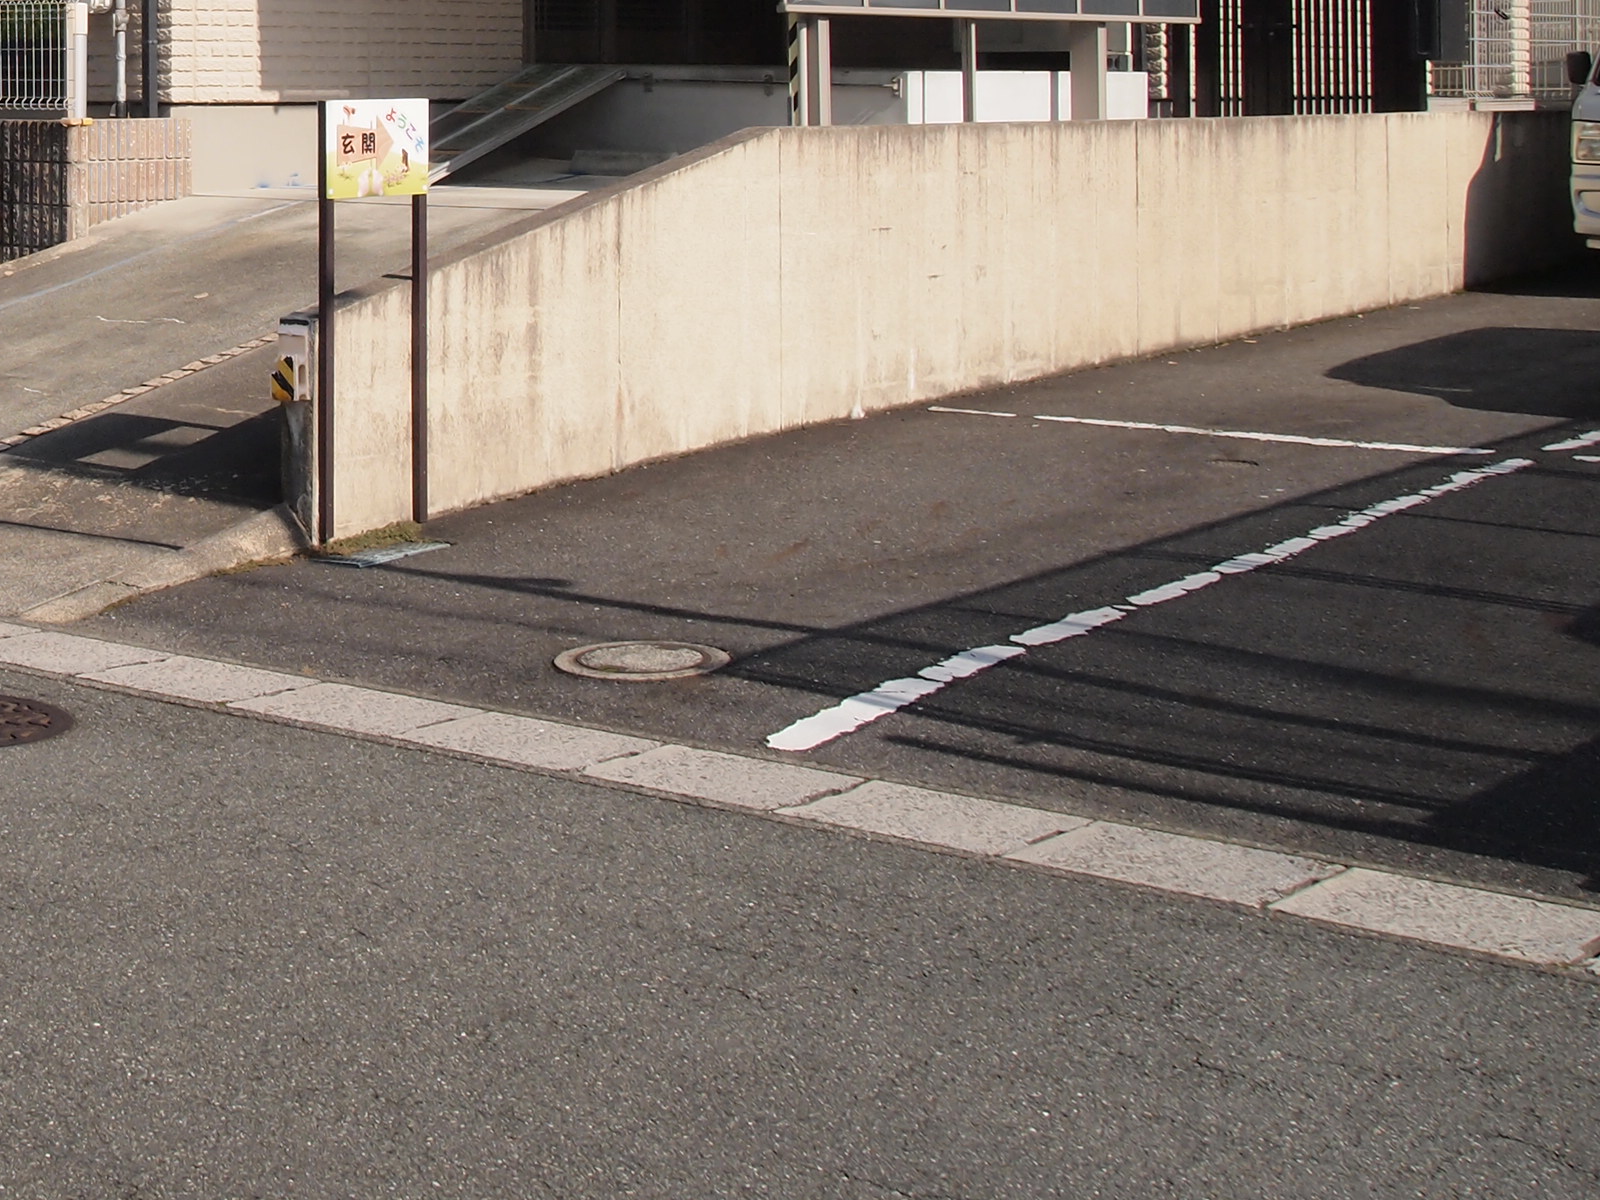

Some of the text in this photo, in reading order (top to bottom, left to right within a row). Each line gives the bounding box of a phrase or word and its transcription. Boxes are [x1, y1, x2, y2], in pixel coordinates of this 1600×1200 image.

[341, 132, 376, 155] 玄関
[385, 107, 425, 153] ようこそ
